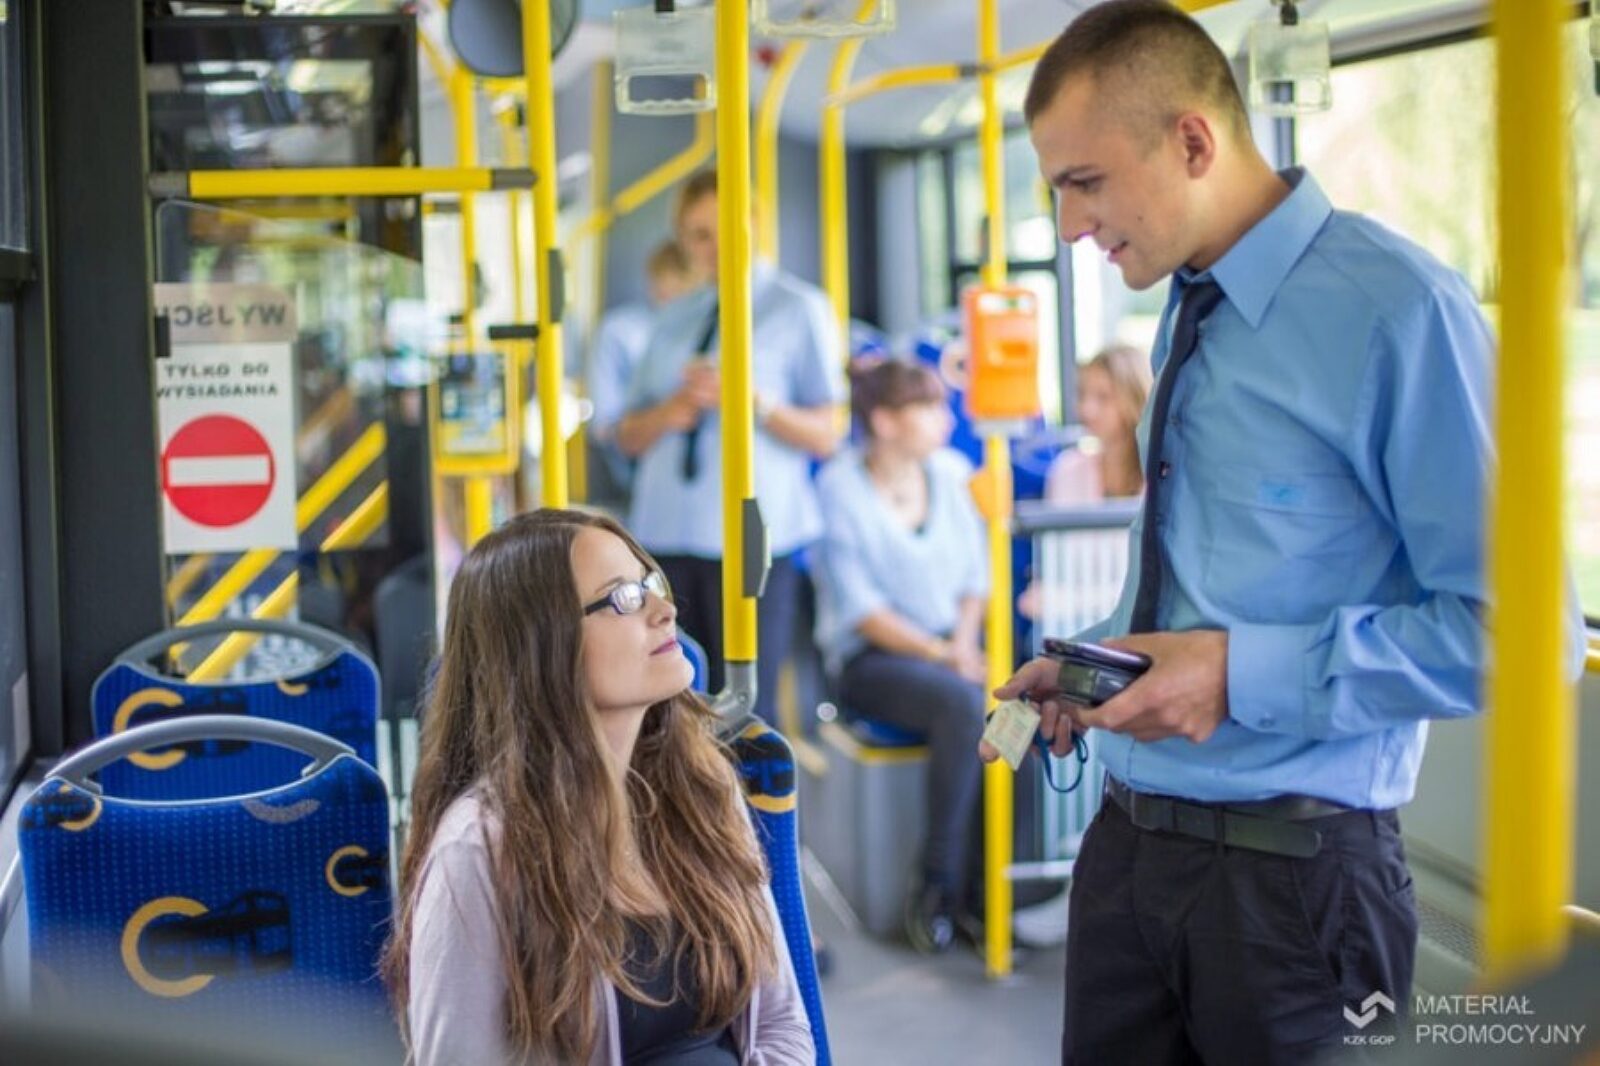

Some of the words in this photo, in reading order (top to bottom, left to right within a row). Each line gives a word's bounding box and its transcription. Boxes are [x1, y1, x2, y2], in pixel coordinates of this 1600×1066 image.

[165, 364, 230, 377] TYLKO
[242, 363, 269, 375] DO
[156, 384, 277, 398] WYSIADANIA
